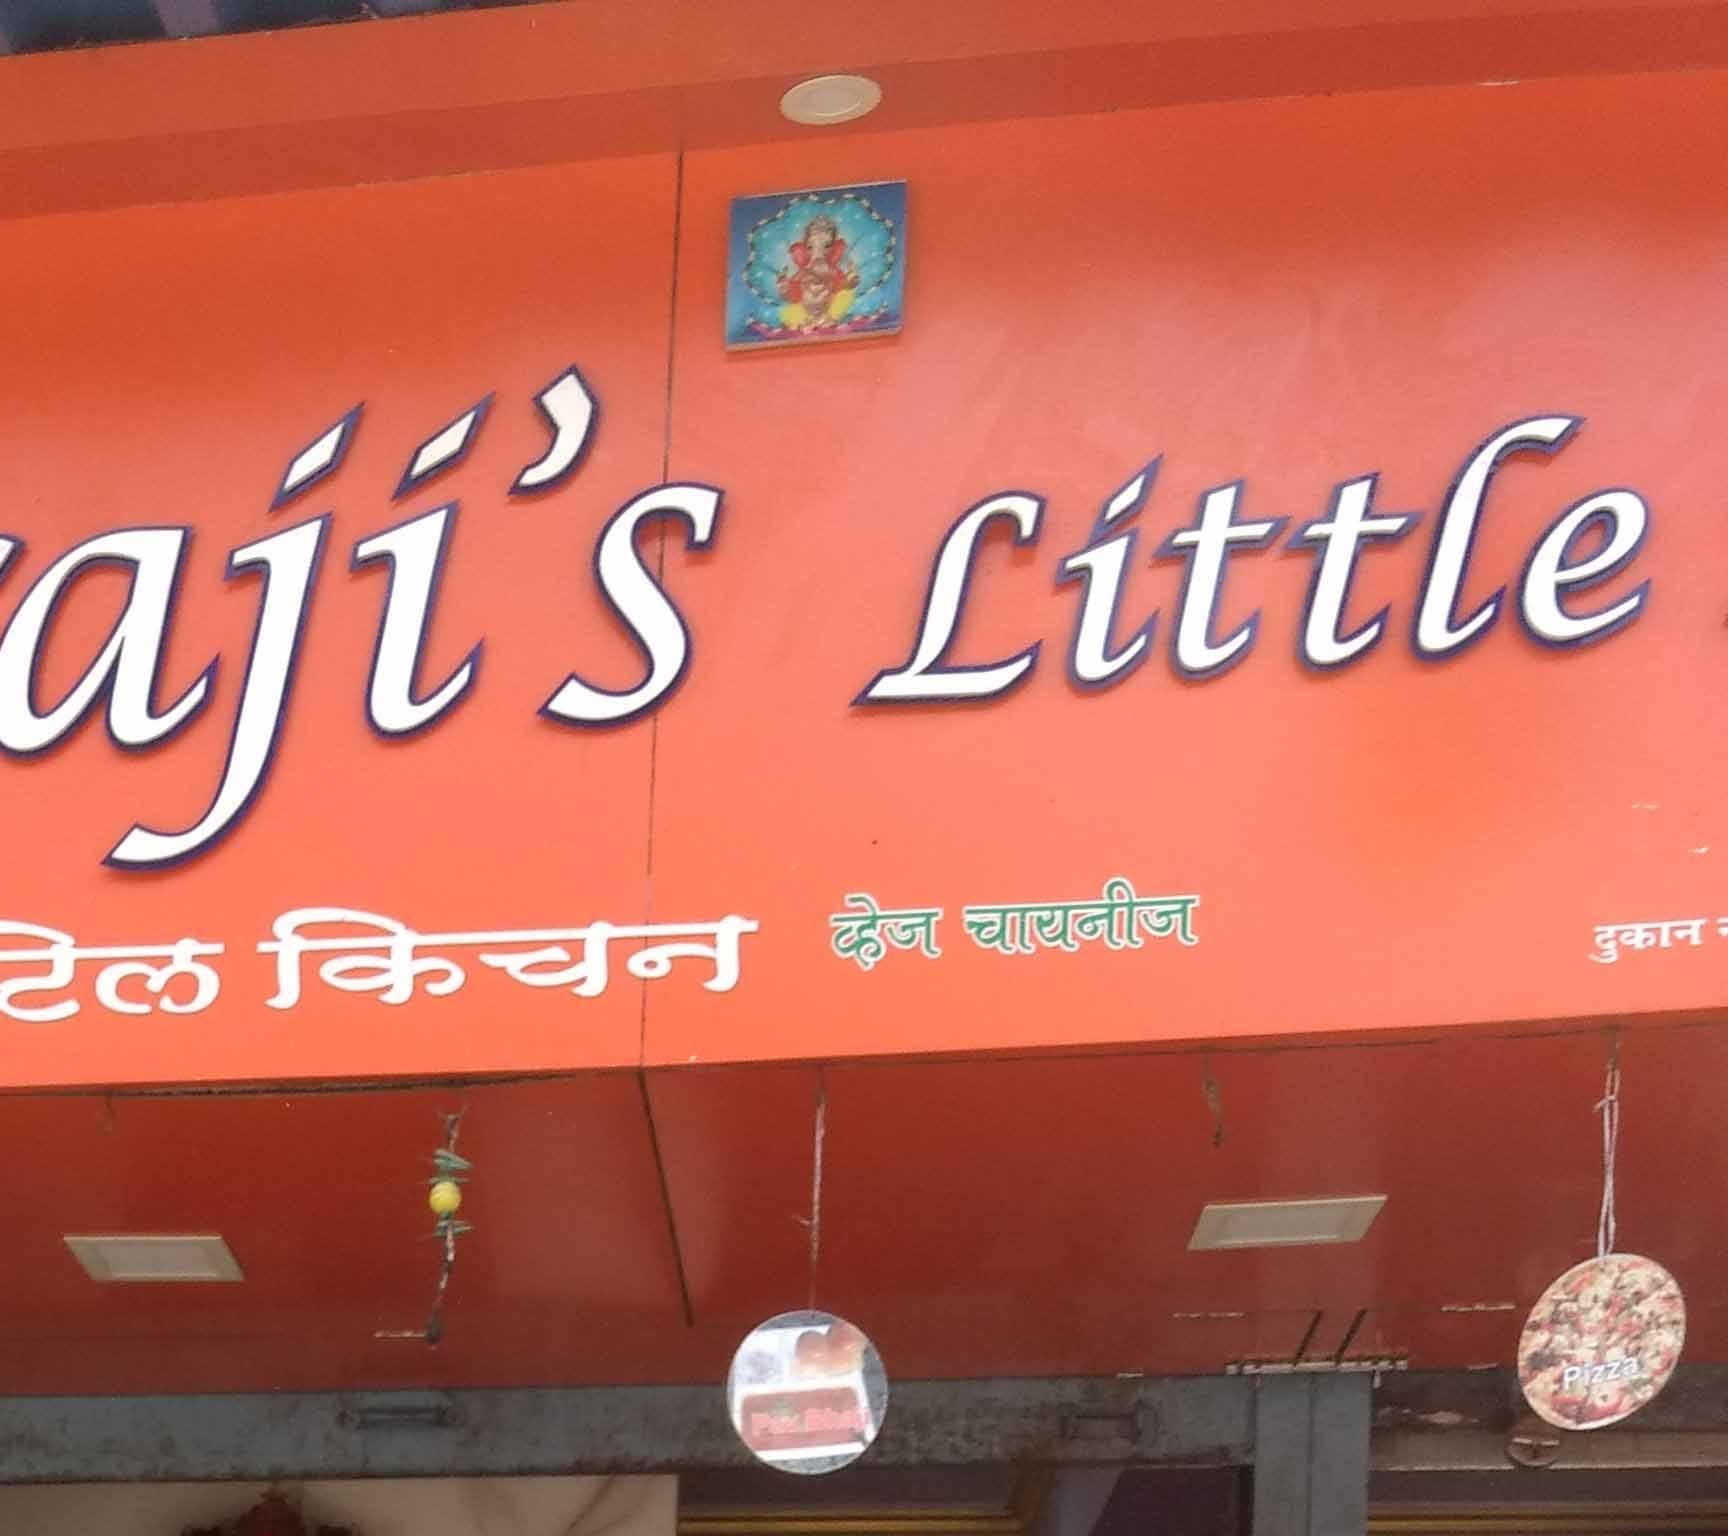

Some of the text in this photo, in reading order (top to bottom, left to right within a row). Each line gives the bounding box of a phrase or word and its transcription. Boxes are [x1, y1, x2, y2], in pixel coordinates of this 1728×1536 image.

[850, 413, 1652, 709] Little
[257, 907, 759, 1010] किचन
[830, 876, 1200, 971] व्हेज चायनीज
[1585, 917, 1707, 965] दुकान
[1563, 1357, 1641, 1390] Pizza
